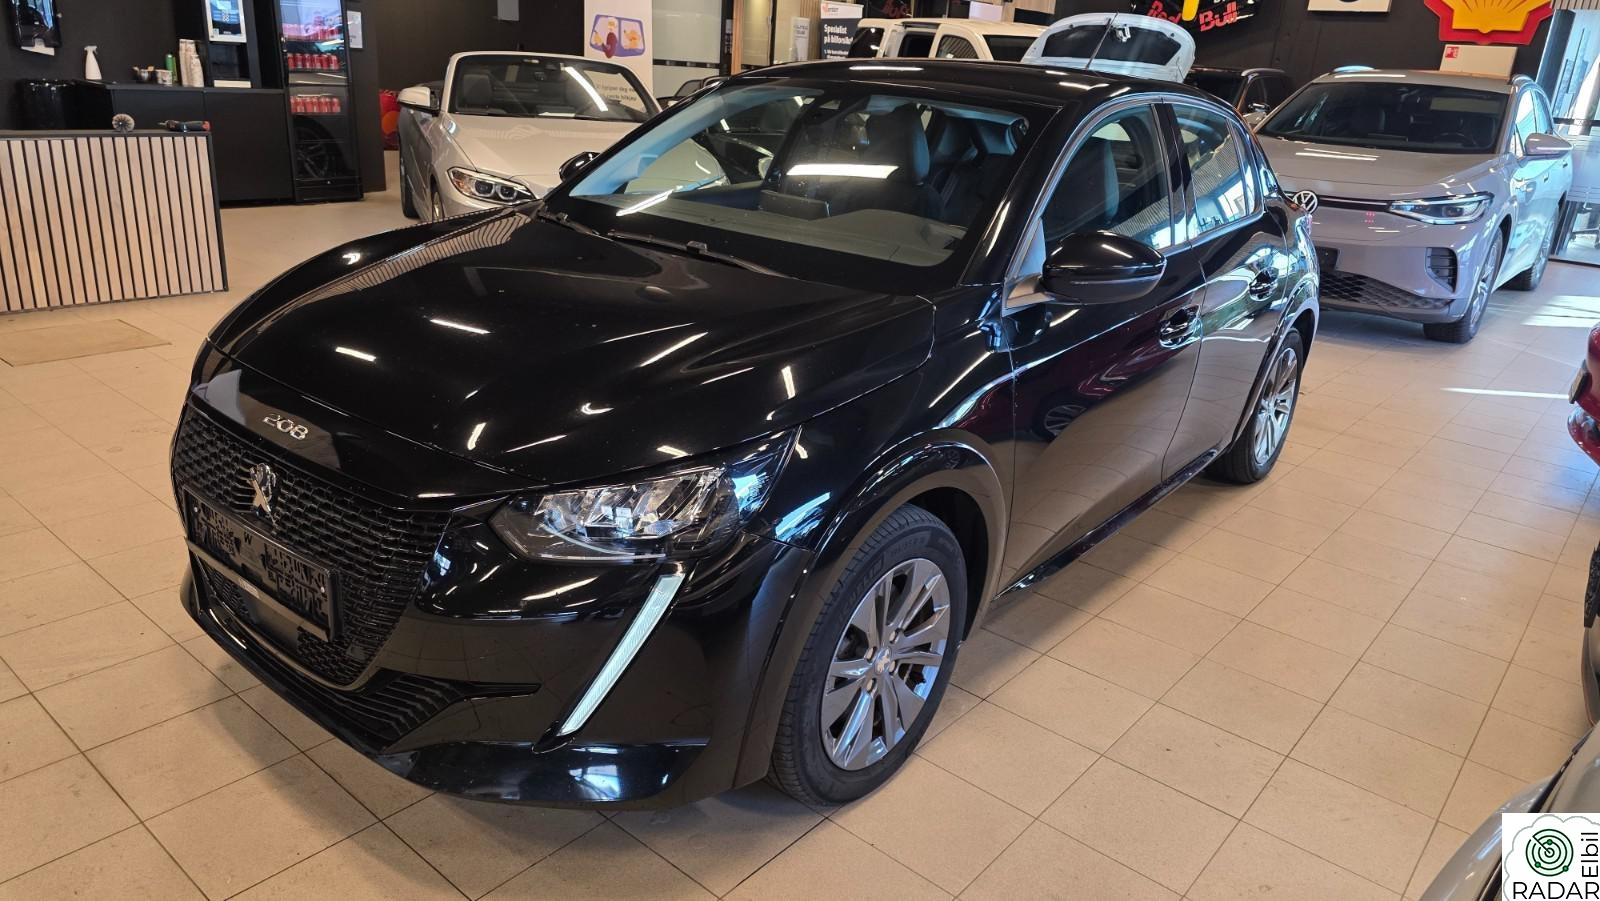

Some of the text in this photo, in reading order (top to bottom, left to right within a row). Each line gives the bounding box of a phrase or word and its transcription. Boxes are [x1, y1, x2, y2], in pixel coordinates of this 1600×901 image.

[1199, 1, 1238, 32] Bull
[830, 34, 854, 45] bilforsikr
[263, 413, 308, 440] 208
